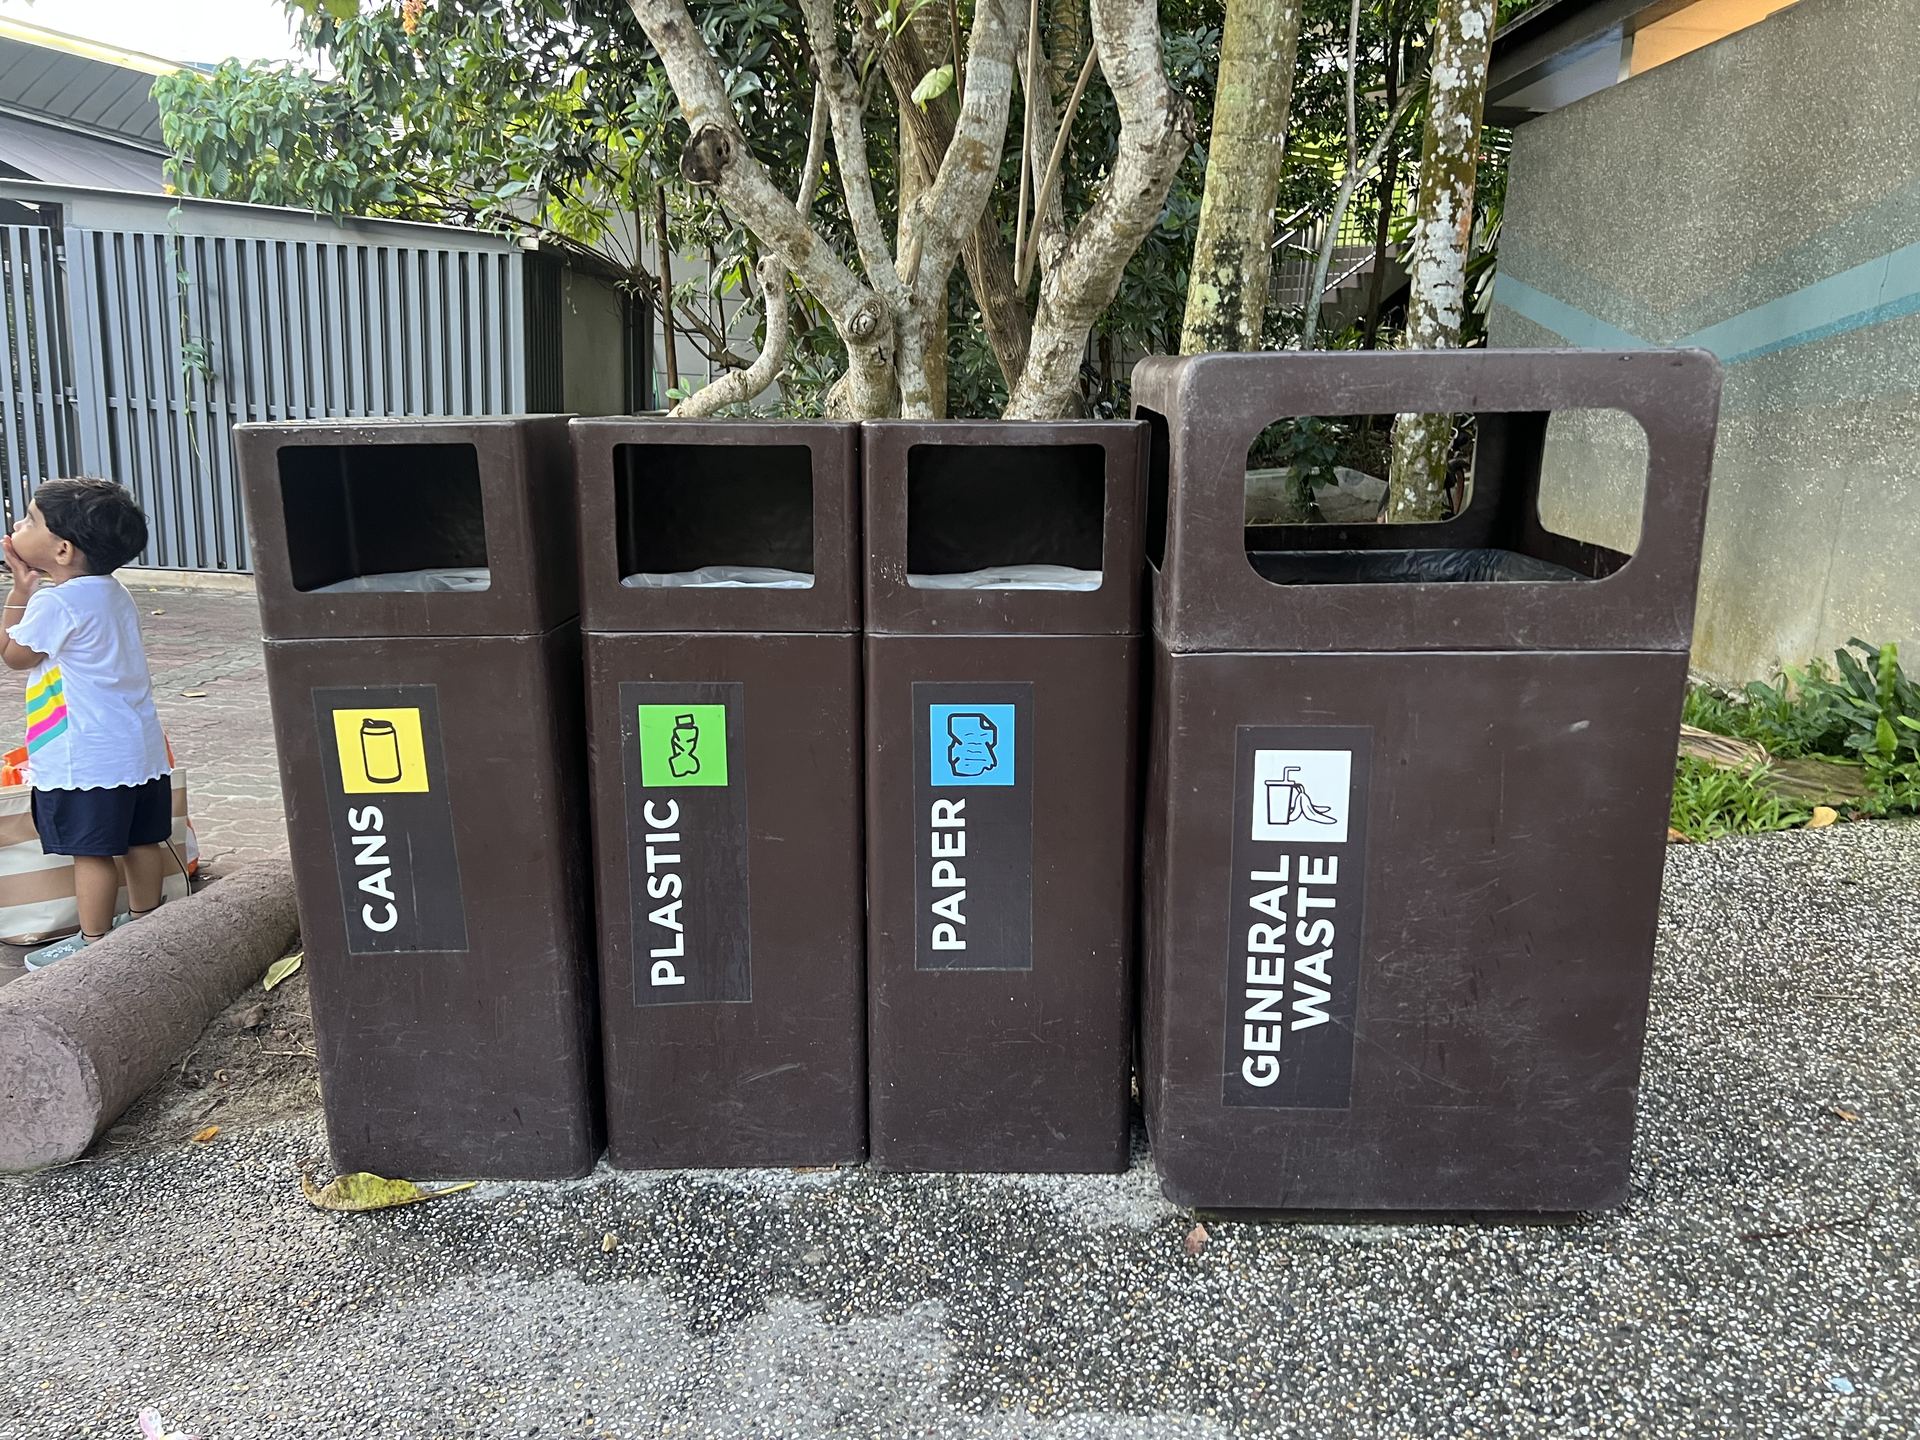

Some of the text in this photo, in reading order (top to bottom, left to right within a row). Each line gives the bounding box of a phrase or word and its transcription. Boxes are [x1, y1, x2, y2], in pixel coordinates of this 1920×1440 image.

[348, 806, 397, 932] CANS
[644, 799, 685, 985] PLASTIC
[932, 799, 966, 950] PAPER
[1291, 856, 1338, 1031] WASTE
[1242, 855, 1289, 1087] GENERAL
